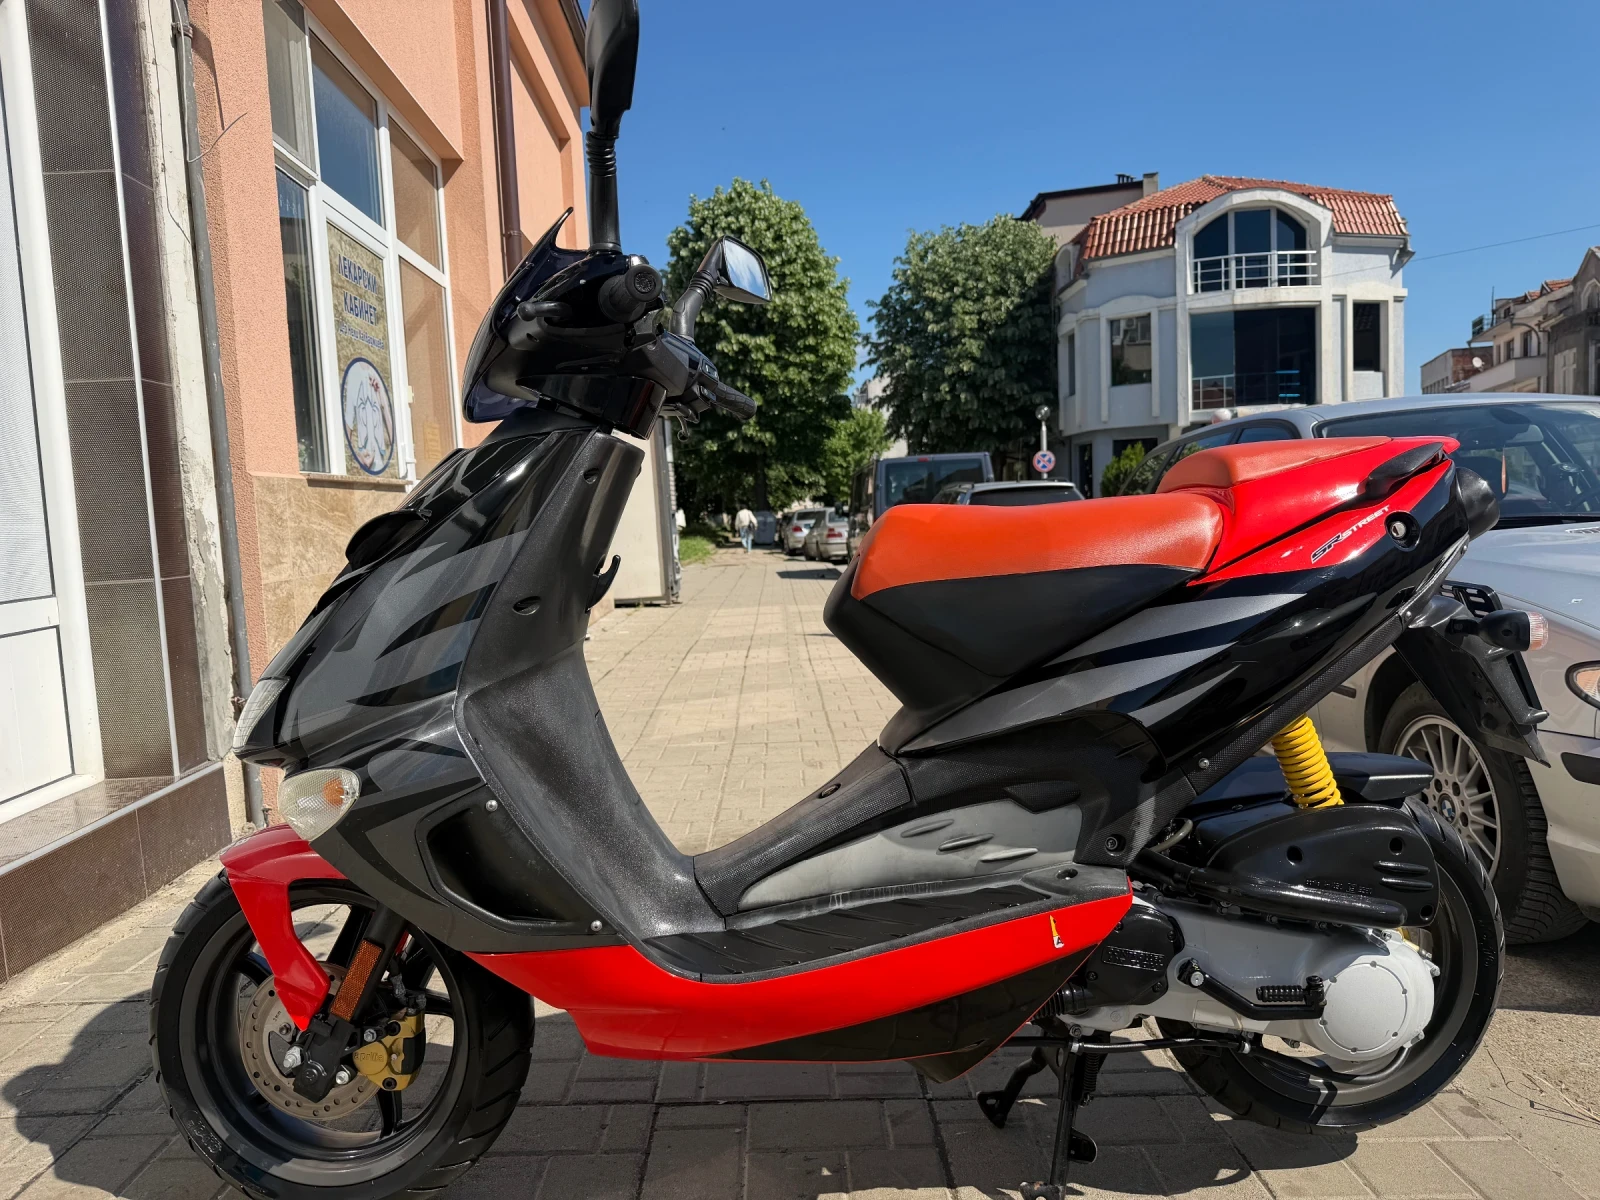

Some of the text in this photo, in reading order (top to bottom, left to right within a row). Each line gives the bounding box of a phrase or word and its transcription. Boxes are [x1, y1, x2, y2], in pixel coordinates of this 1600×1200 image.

[338, 254, 377, 294] ЛЕКАРСКИ
[344, 290, 377, 326] КАБИНЕТ
[1311, 532, 1342, 564] SR
[1340, 505, 1390, 540] STREET
